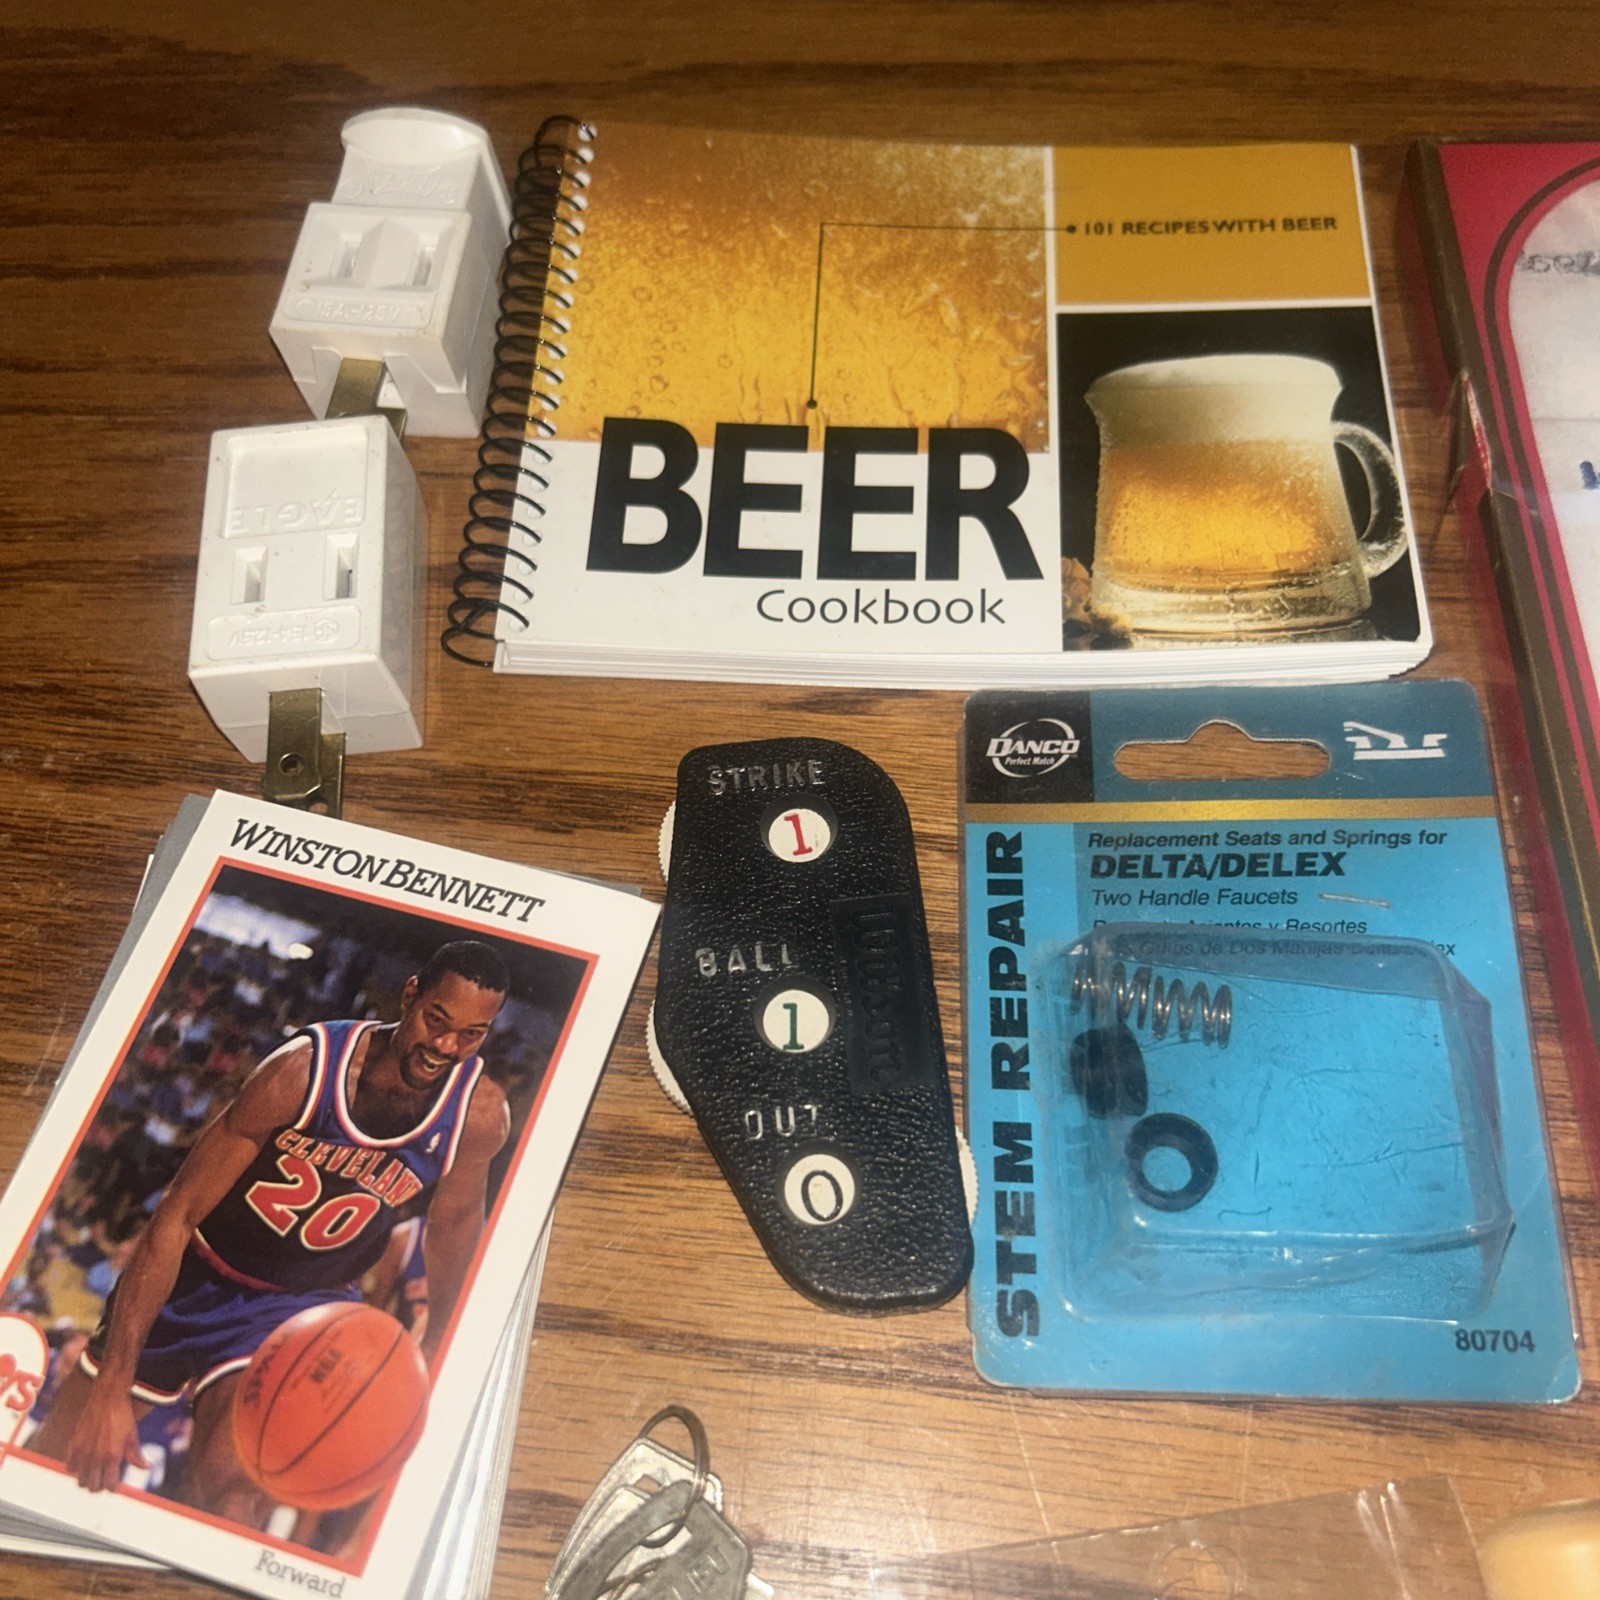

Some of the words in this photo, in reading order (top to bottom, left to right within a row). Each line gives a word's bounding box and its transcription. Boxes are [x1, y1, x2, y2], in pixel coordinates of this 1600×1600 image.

[1084, 221, 1115, 236] 101
[1121, 220, 1211, 235] RECIPES
[1212, 218, 1276, 233] WITH
[1281, 216, 1338, 232] BEER
[229, 487, 364, 534] EAGLE
[586, 417, 1045, 582] BEER
[756, 588, 1007, 625] Cookbook
[985, 738, 1080, 757] DANCO
[1004, 757, 1031, 766] Perfect
[1032, 757, 1055, 766] Match
[707, 758, 826, 796] STRIKE
[783, 813, 813, 856] 1
[1088, 831, 1220, 850] Replacement
[1225, 830, 1283, 847] Seats
[1288, 829, 1332, 846] and
[1334, 828, 1413, 848] Springs
[1417, 828, 1448, 846] for
[229, 817, 393, 883] WINSTON
[380, 858, 547, 924] BENNETT
[1089, 851, 1347, 881] DELTA/DELEX
[1091, 889, 1132, 907] Two
[1138, 887, 1210, 906] Handle
[1216, 887, 1299, 906] Faucets
[695, 942, 797, 978] BALL
[986, 830, 1030, 1090] REPAIR
[782, 1002, 804, 1051] 1
[744, 1104, 819, 1140] OUT
[275, 1127, 424, 1208] CLEVELAN
[246, 1154, 381, 1251] 20
[801, 1169, 844, 1222] 0
[992, 1120, 1041, 1338] STEM
[1454, 1328, 1536, 1353] 80704
[255, 1548, 346, 1599] Forward
